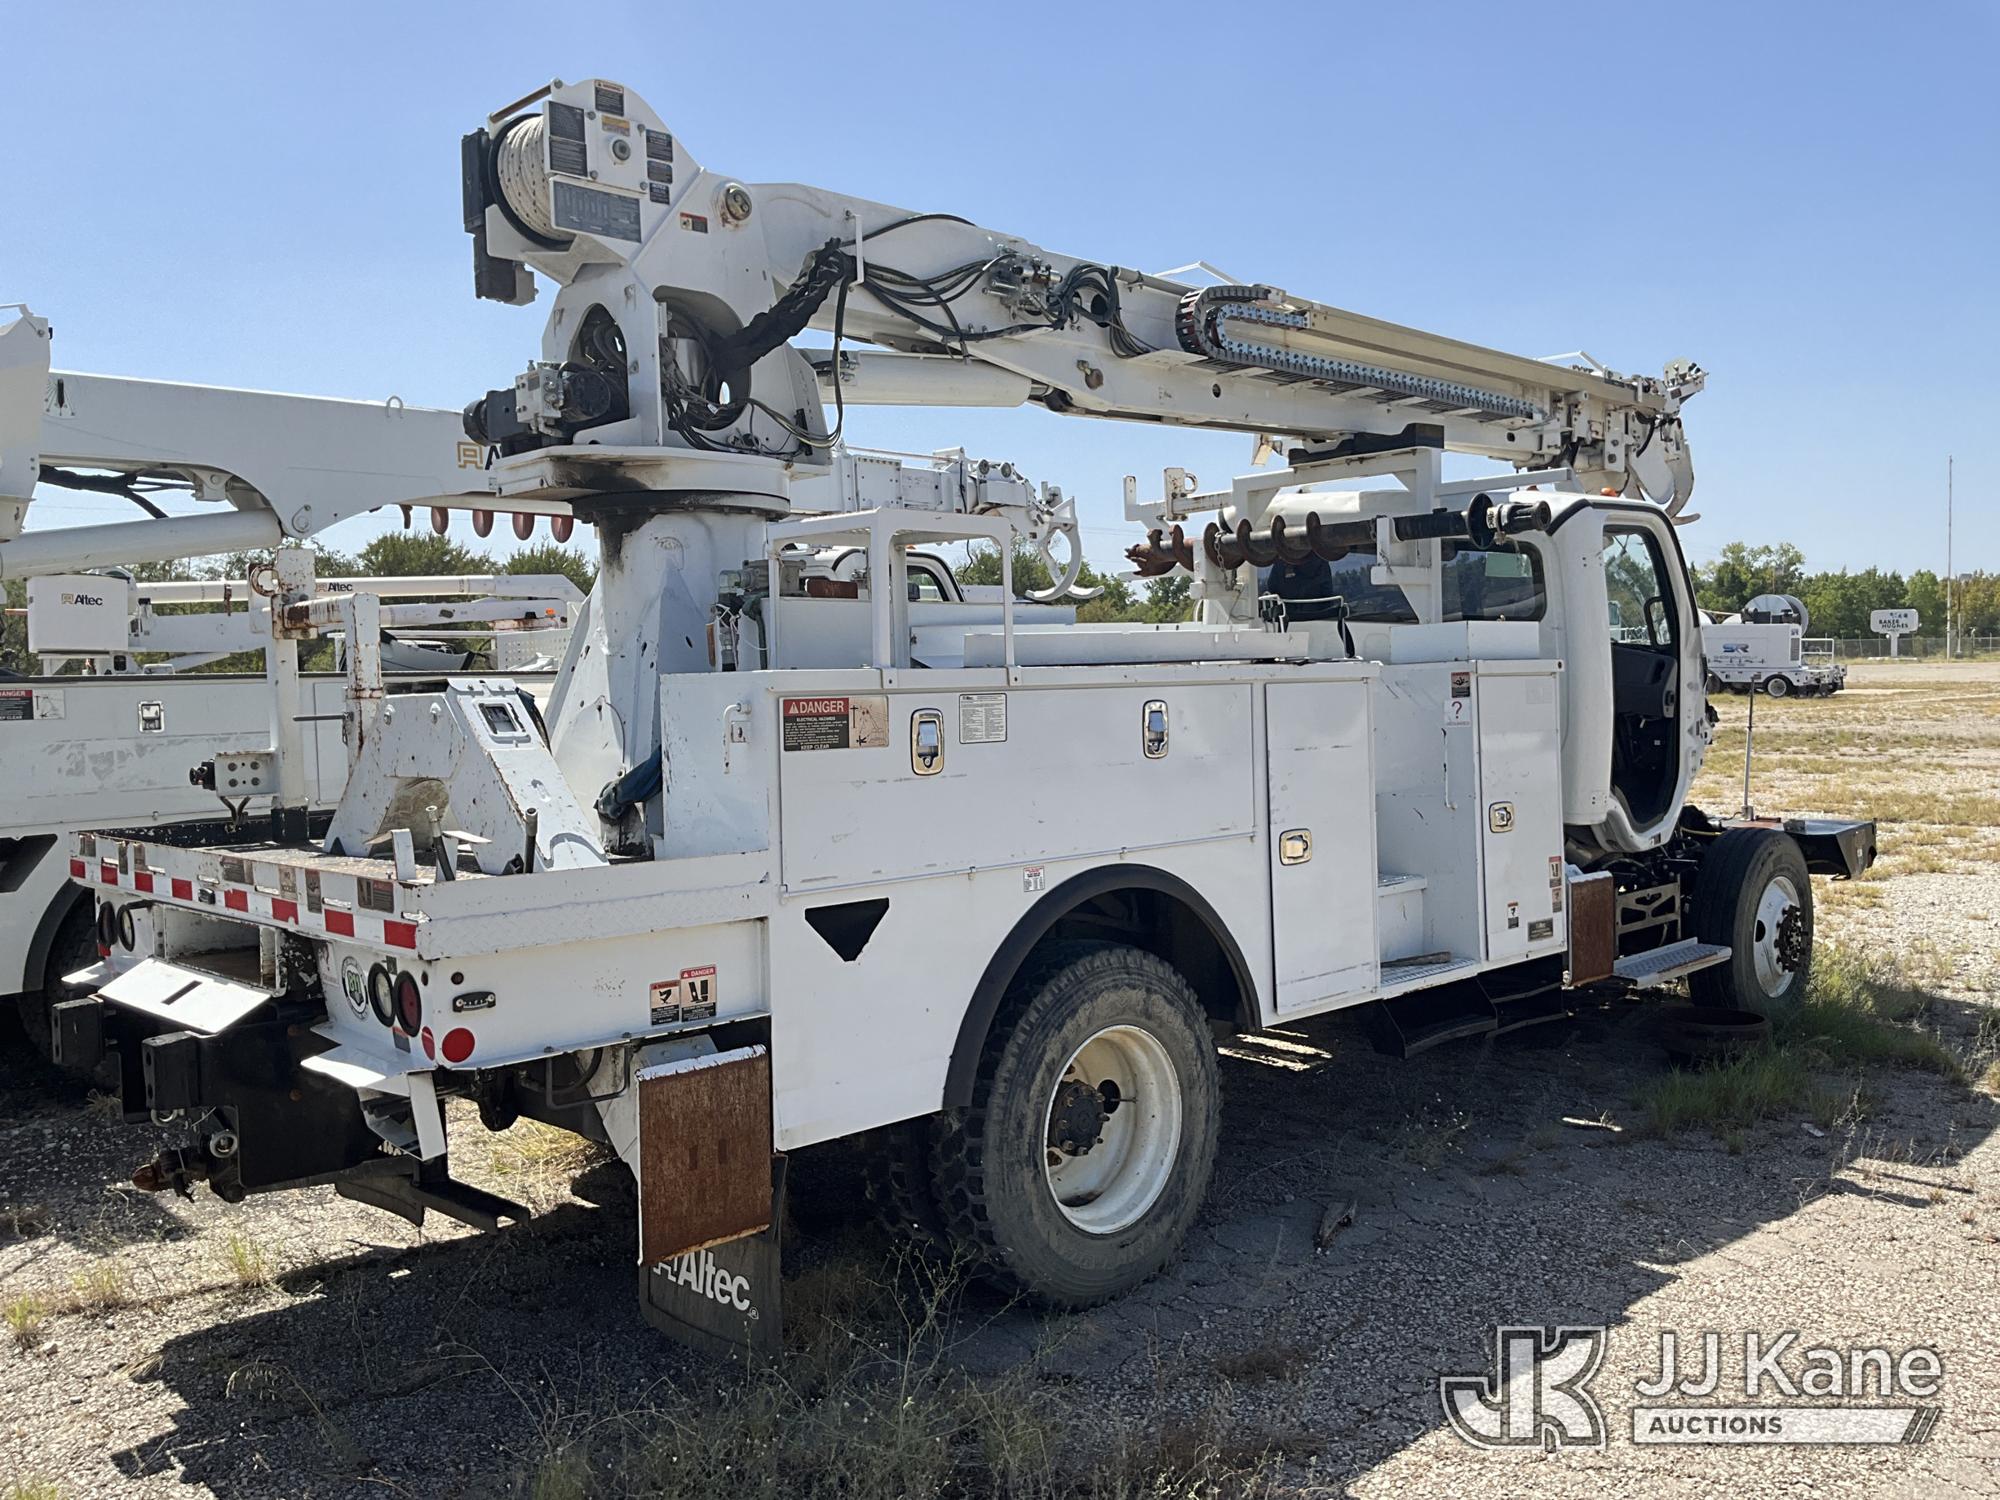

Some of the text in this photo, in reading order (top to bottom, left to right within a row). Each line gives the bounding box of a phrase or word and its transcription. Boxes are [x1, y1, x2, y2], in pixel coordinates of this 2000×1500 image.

[327, 582, 353, 592] Altec
[74, 594, 103, 606] Altec
[800, 700, 844, 713] DANGER
[690, 967, 714, 977] DANGER
[678, 1249, 750, 1311] Altec
